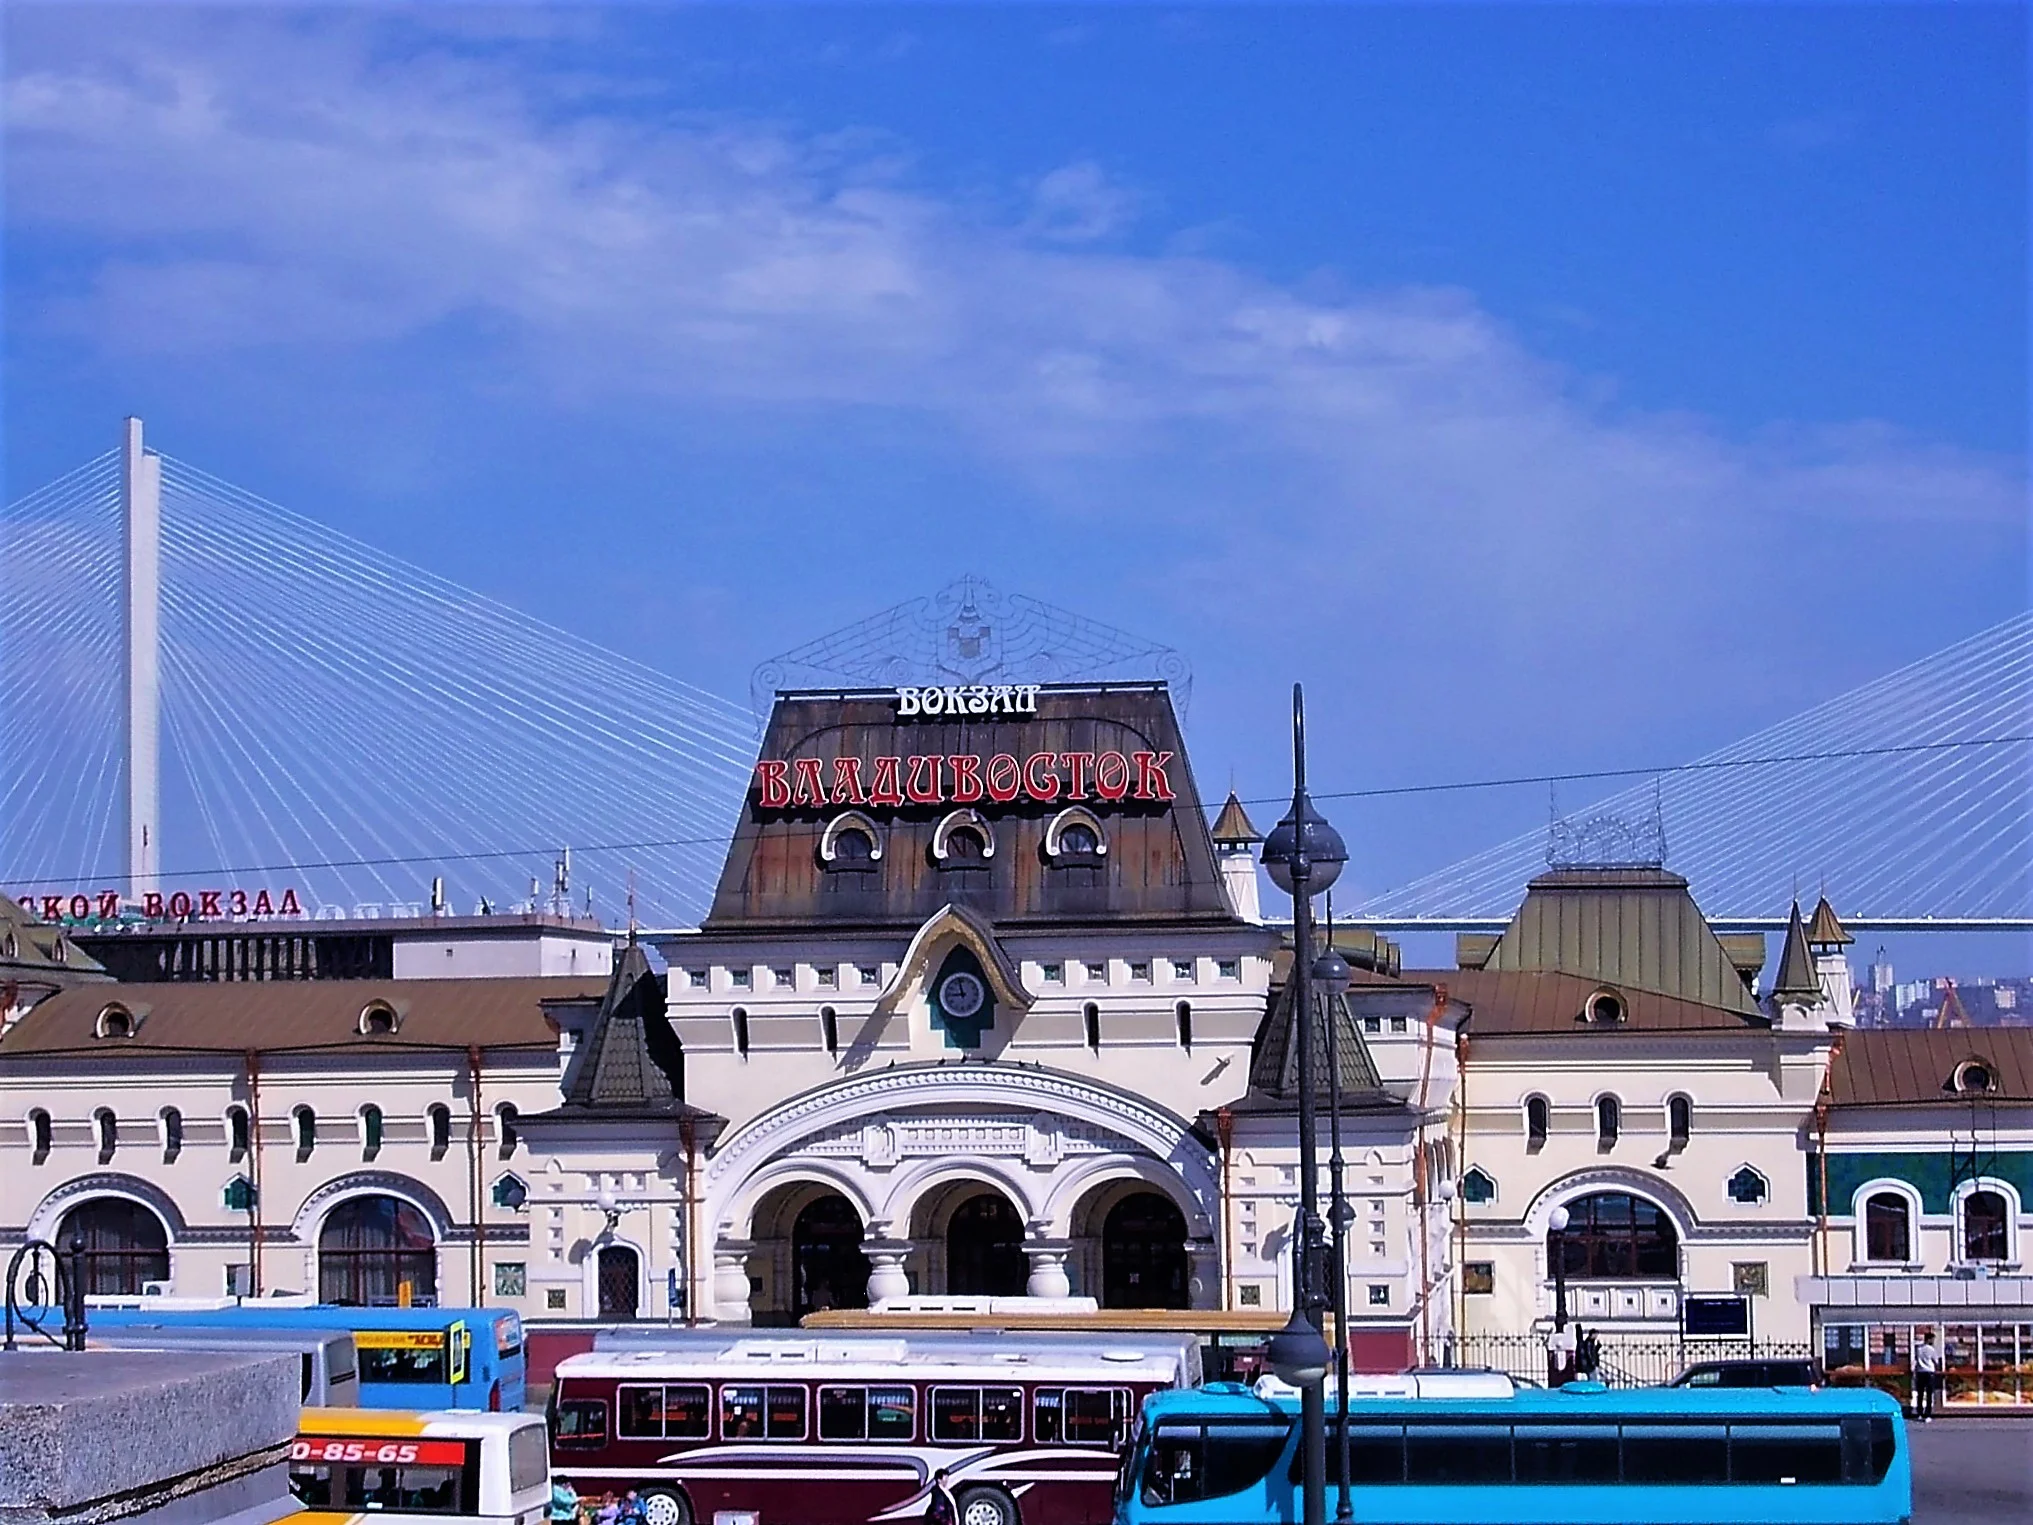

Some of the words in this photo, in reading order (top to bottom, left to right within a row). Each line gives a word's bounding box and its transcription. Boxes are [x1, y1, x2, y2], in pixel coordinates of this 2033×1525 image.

[895, 684, 1040, 716] ВОКЗАЛ
[755, 750, 1177, 808] ВЛАДИВОСТОК
[142, 888, 301, 918] ВОКЗАЛ
